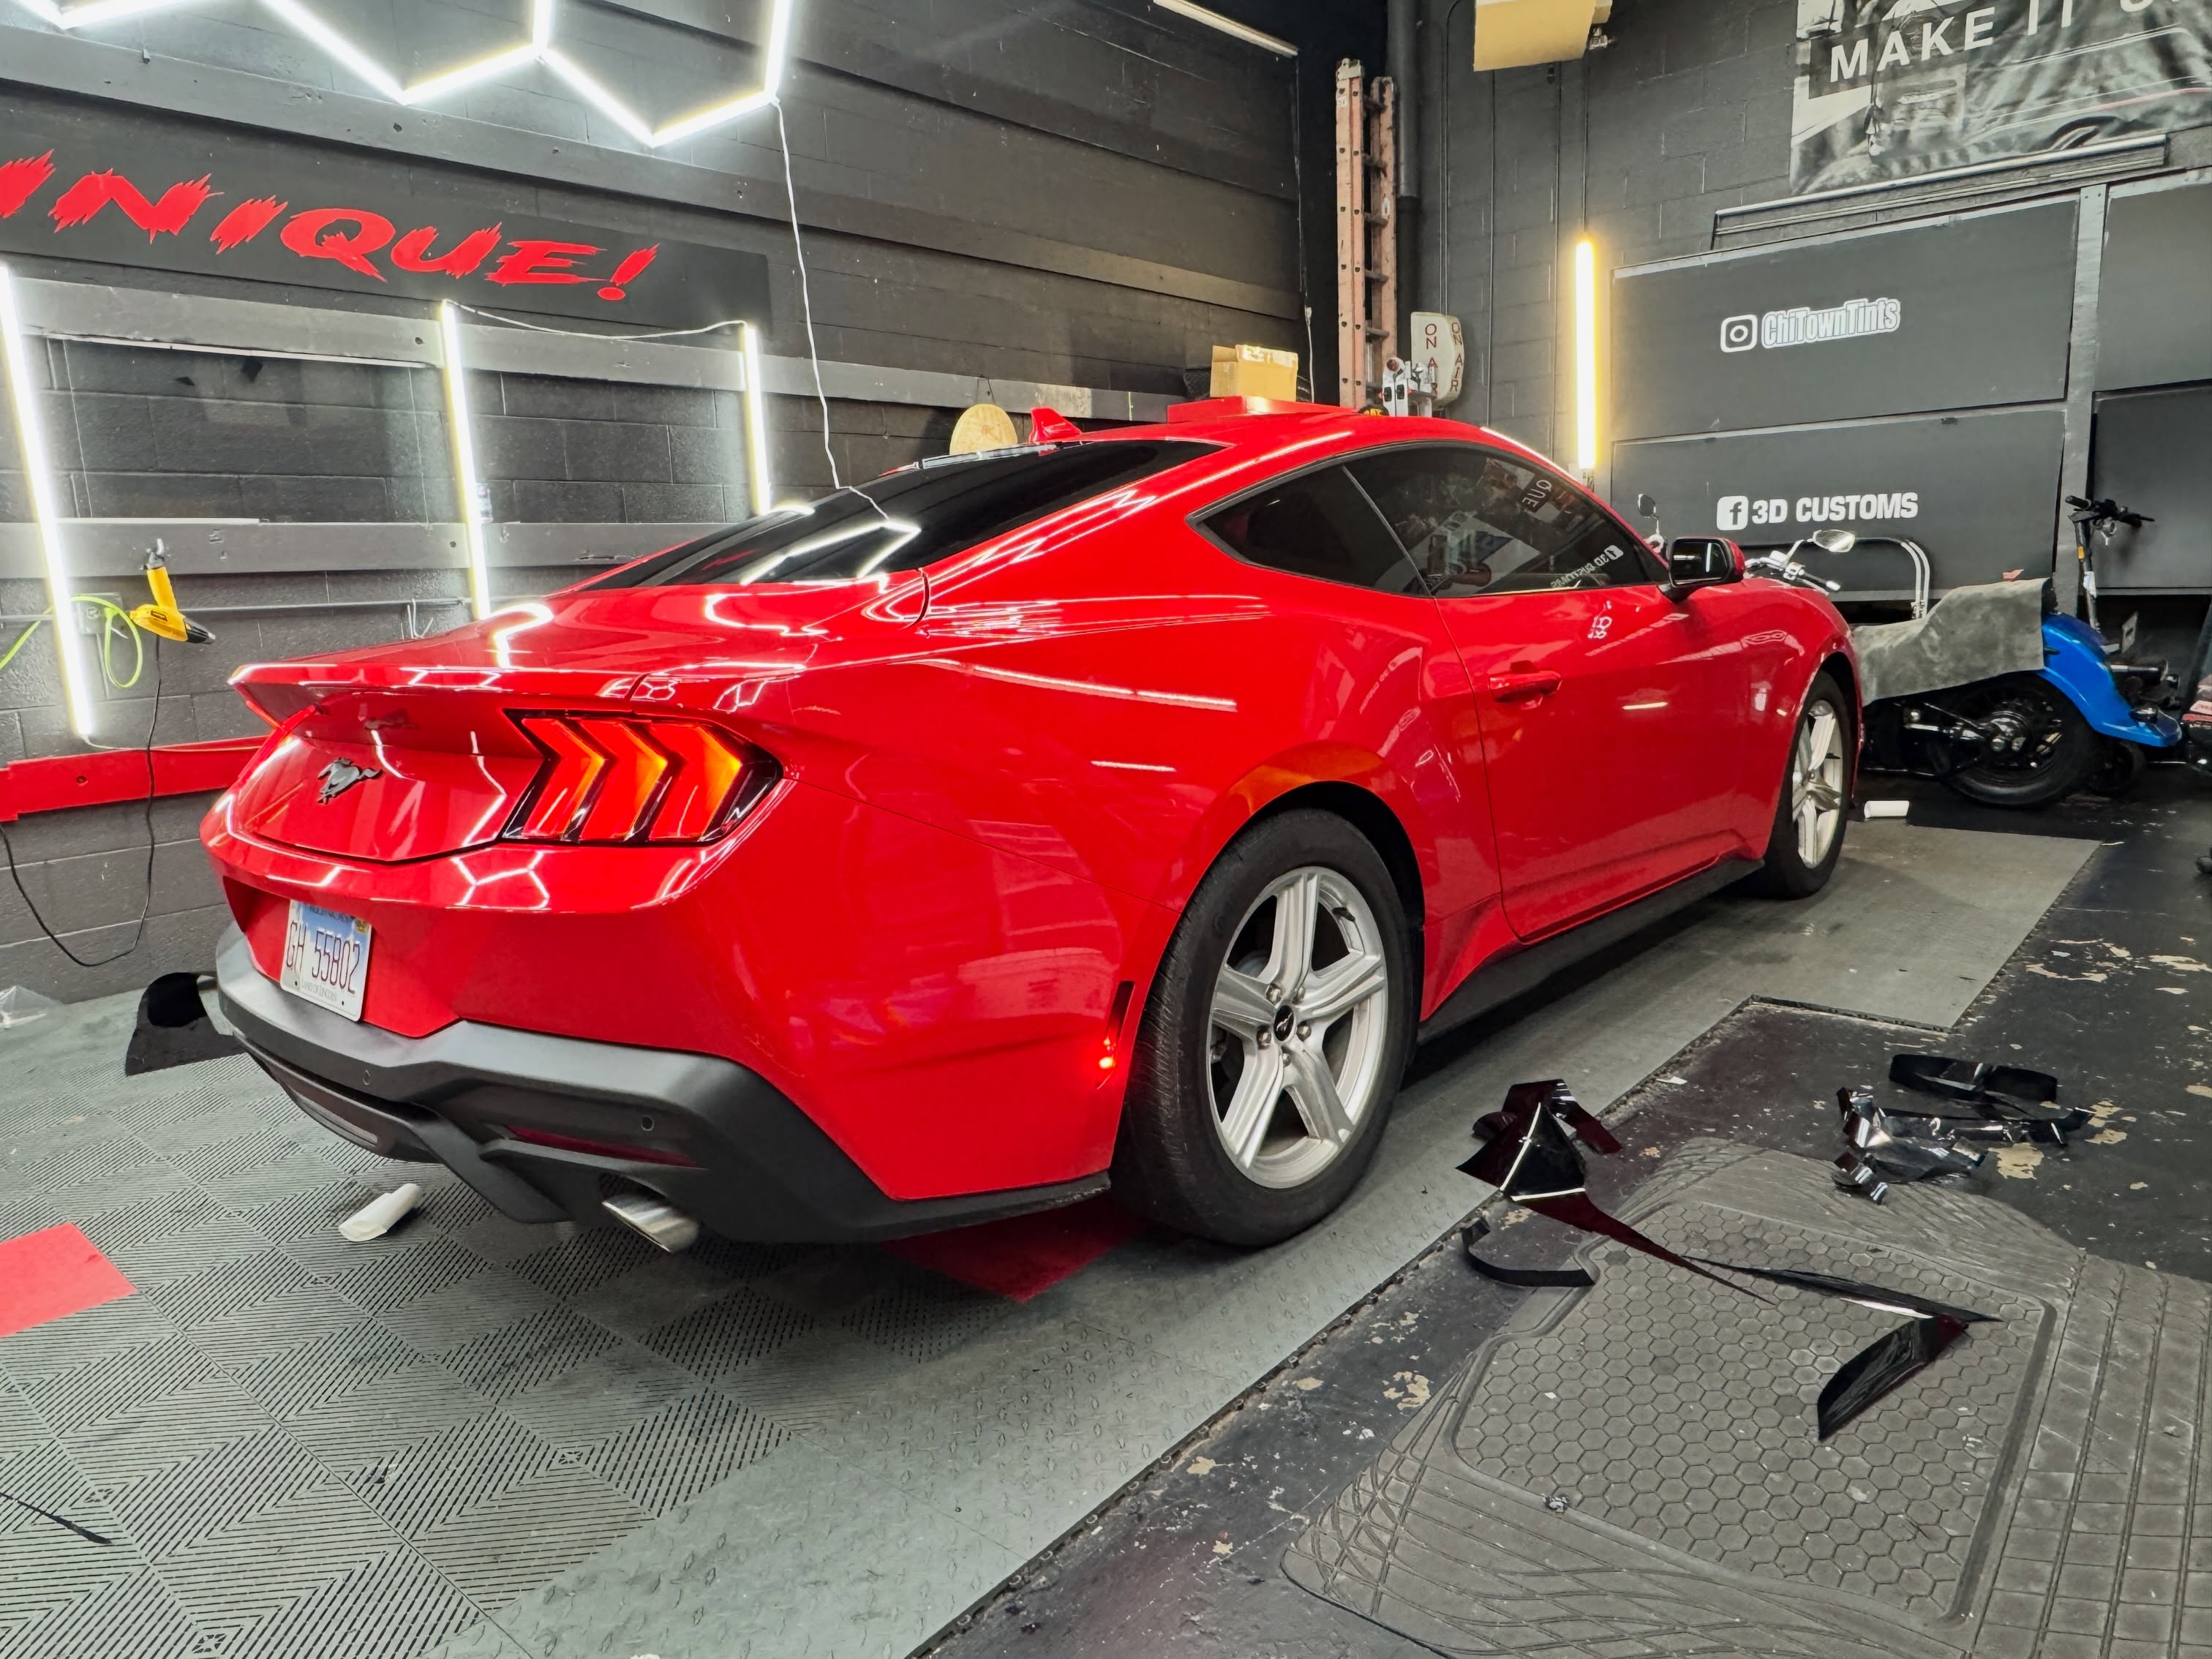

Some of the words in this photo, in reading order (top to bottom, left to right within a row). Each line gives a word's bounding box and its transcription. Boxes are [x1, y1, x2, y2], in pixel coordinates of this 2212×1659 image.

[1830, 7, 1995, 83] MAKE
[1425, 323, 1437, 350] ON
[1451, 322, 1462, 345] ON
[1761, 297, 1900, 349] ChiTownTints
[1450, 353, 1463, 392] AIR
[1751, 499, 1788, 524] 3D
[1795, 492, 1918, 522] CUSTOMS
[286, 922, 308, 972] GH
[312, 928, 361, 995] 55802
